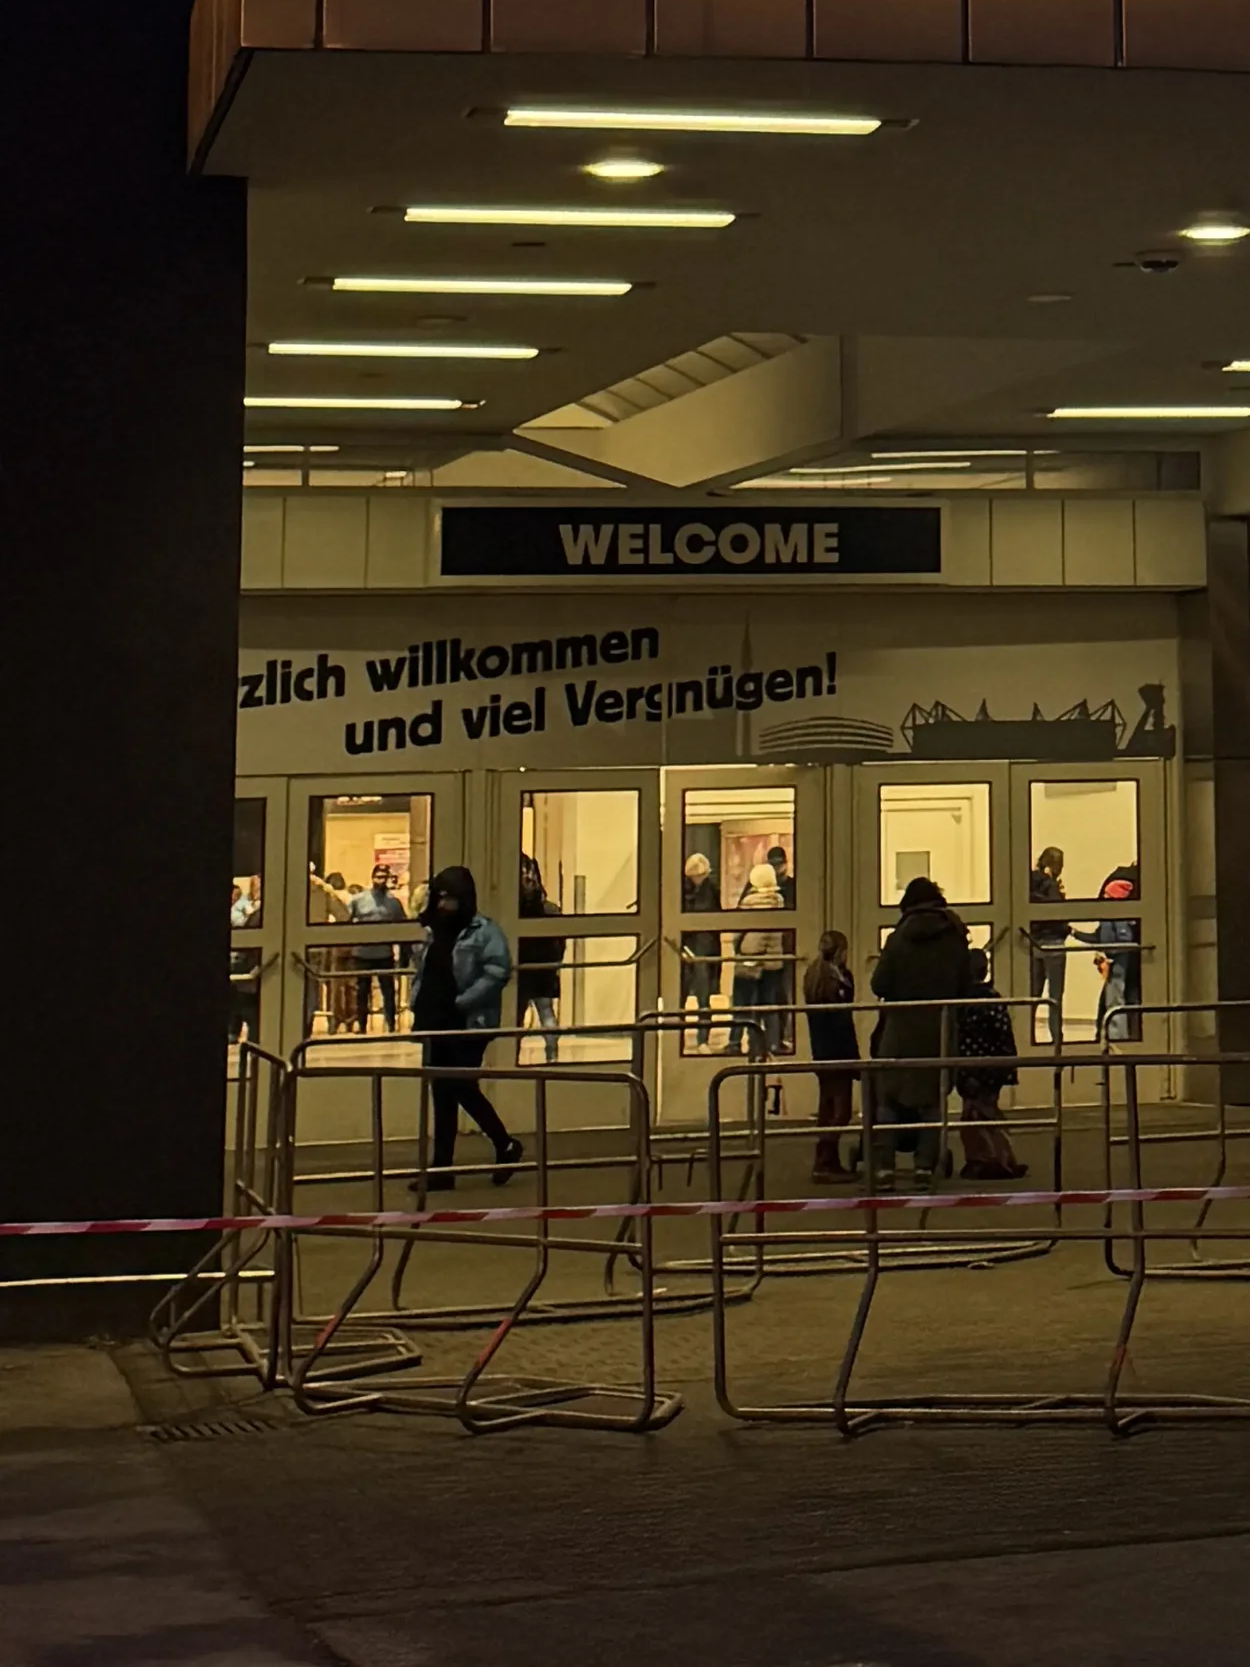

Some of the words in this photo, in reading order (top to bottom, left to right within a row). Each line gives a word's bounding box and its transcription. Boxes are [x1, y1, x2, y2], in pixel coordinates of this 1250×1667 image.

[559, 522, 840, 566] WELCOME
[238, 653, 346, 708] zlich
[366, 626, 660, 693] willkommen
[344, 700, 443, 755] und
[462, 686, 546, 740] viel
[565, 652, 838, 727] Vergnügen!
